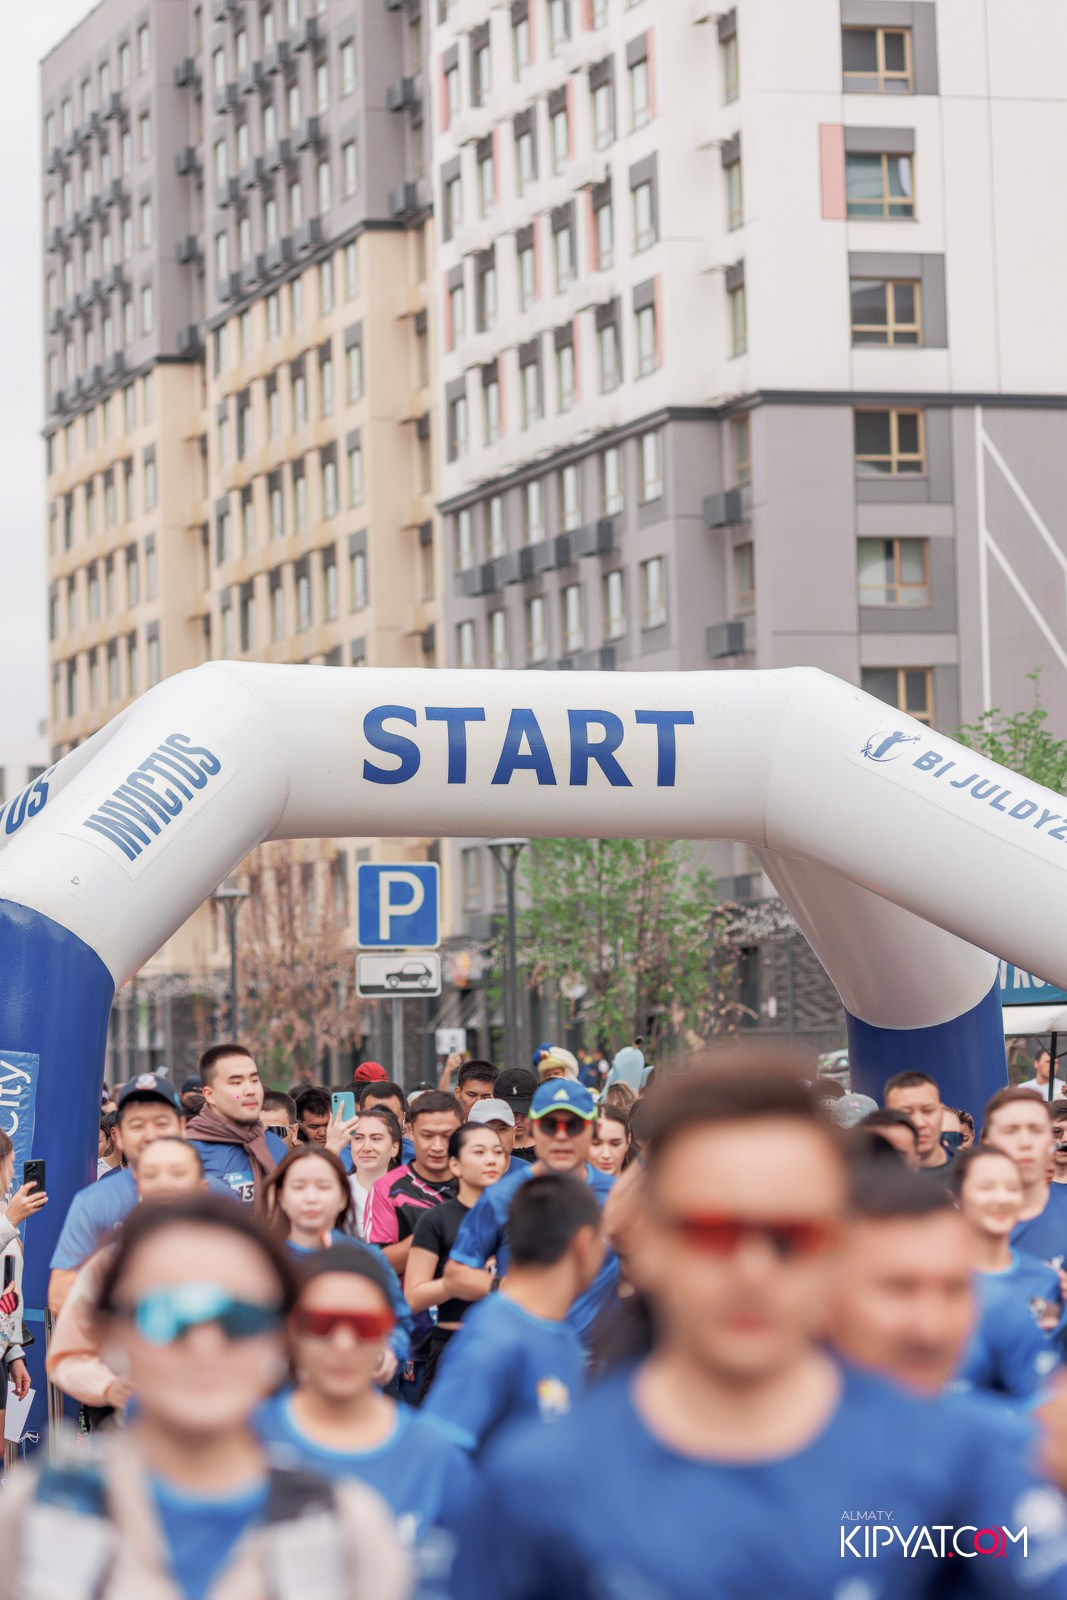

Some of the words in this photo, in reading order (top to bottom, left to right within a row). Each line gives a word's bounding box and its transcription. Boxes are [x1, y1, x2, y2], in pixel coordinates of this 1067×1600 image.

[363, 704, 695, 787] START
[82, 733, 222, 862] INVICTUS
[912, 750, 956, 778] BI
[949, 773, 1067, 843] JULDYZ
[379, 871, 425, 940] P
